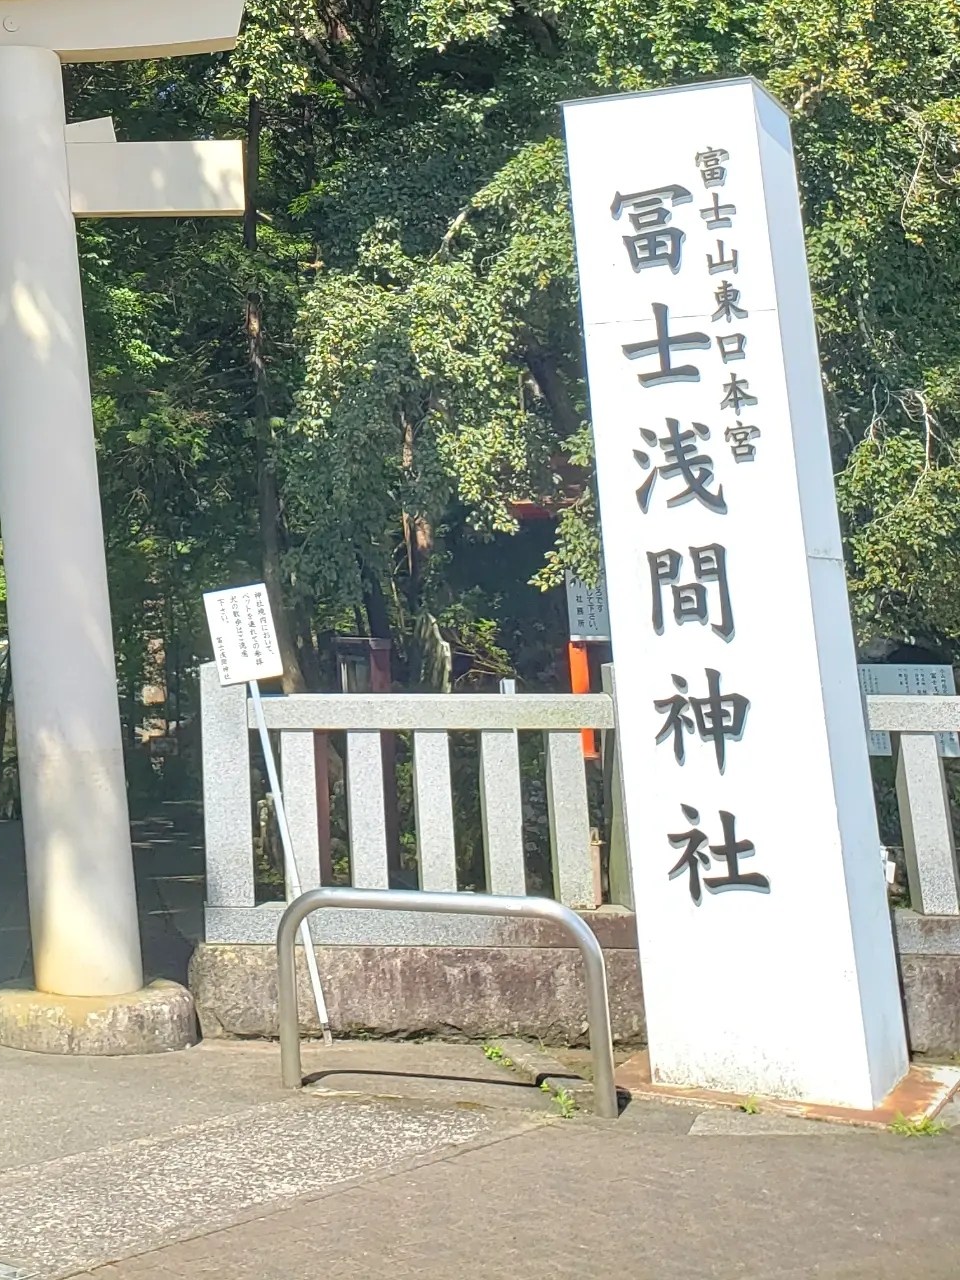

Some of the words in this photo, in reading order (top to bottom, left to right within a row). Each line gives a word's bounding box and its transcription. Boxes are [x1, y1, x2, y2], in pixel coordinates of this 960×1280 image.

[610, 184, 771, 907] 冨士浅間神社
[694, 146, 759, 463] 富士山東口本宮
